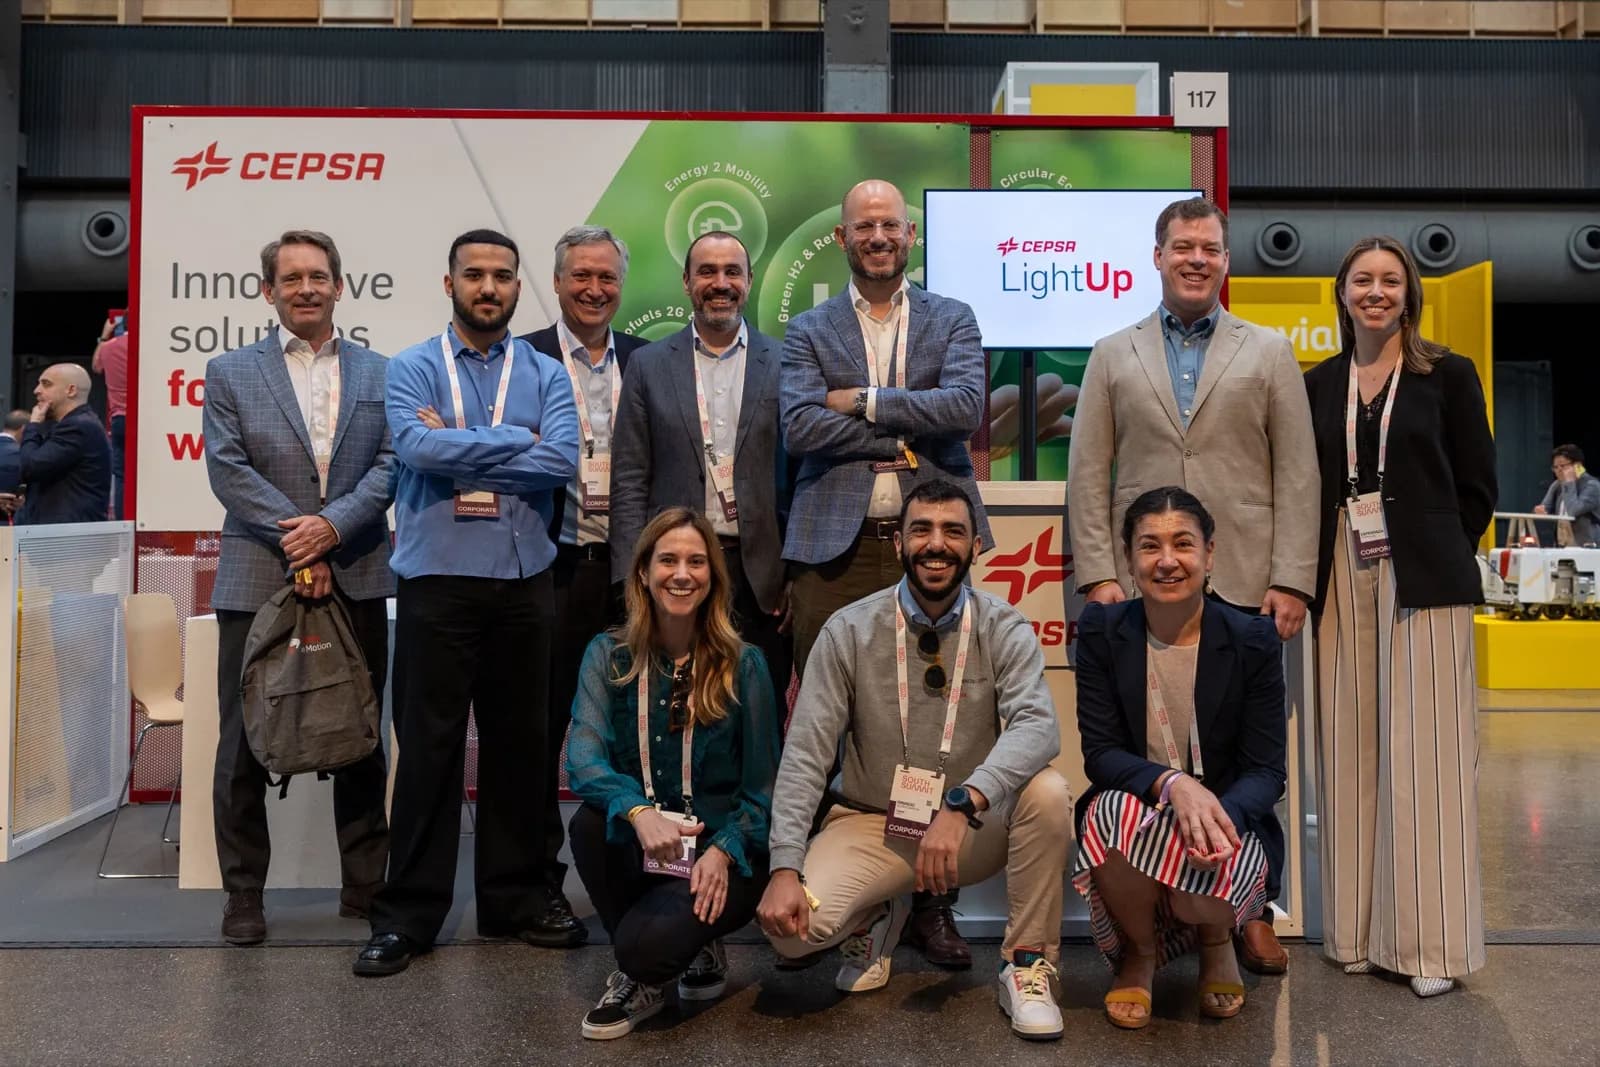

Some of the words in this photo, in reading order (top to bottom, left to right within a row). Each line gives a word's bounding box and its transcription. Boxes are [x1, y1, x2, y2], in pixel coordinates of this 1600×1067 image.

[1187, 91, 1216, 108] 117
[240, 153, 385, 180] CEPSA
[1000, 168, 1056, 188] Circular
[664, 165, 709, 192] Energy
[713, 162, 721, 172] 2
[725, 163, 772, 199] Mobility
[1022, 241, 1077, 252] CEPSA
[778, 282, 795, 323] Green
[787, 260, 805, 280] H2
[802, 248, 815, 261] &
[1002, 262, 1133, 300] LightUp
[624, 309, 662, 335] ofuels
[666, 306, 684, 318] 2G
[902, 775, 930, 786] SOUTH
[888, 823, 927, 837] CORPORAT
